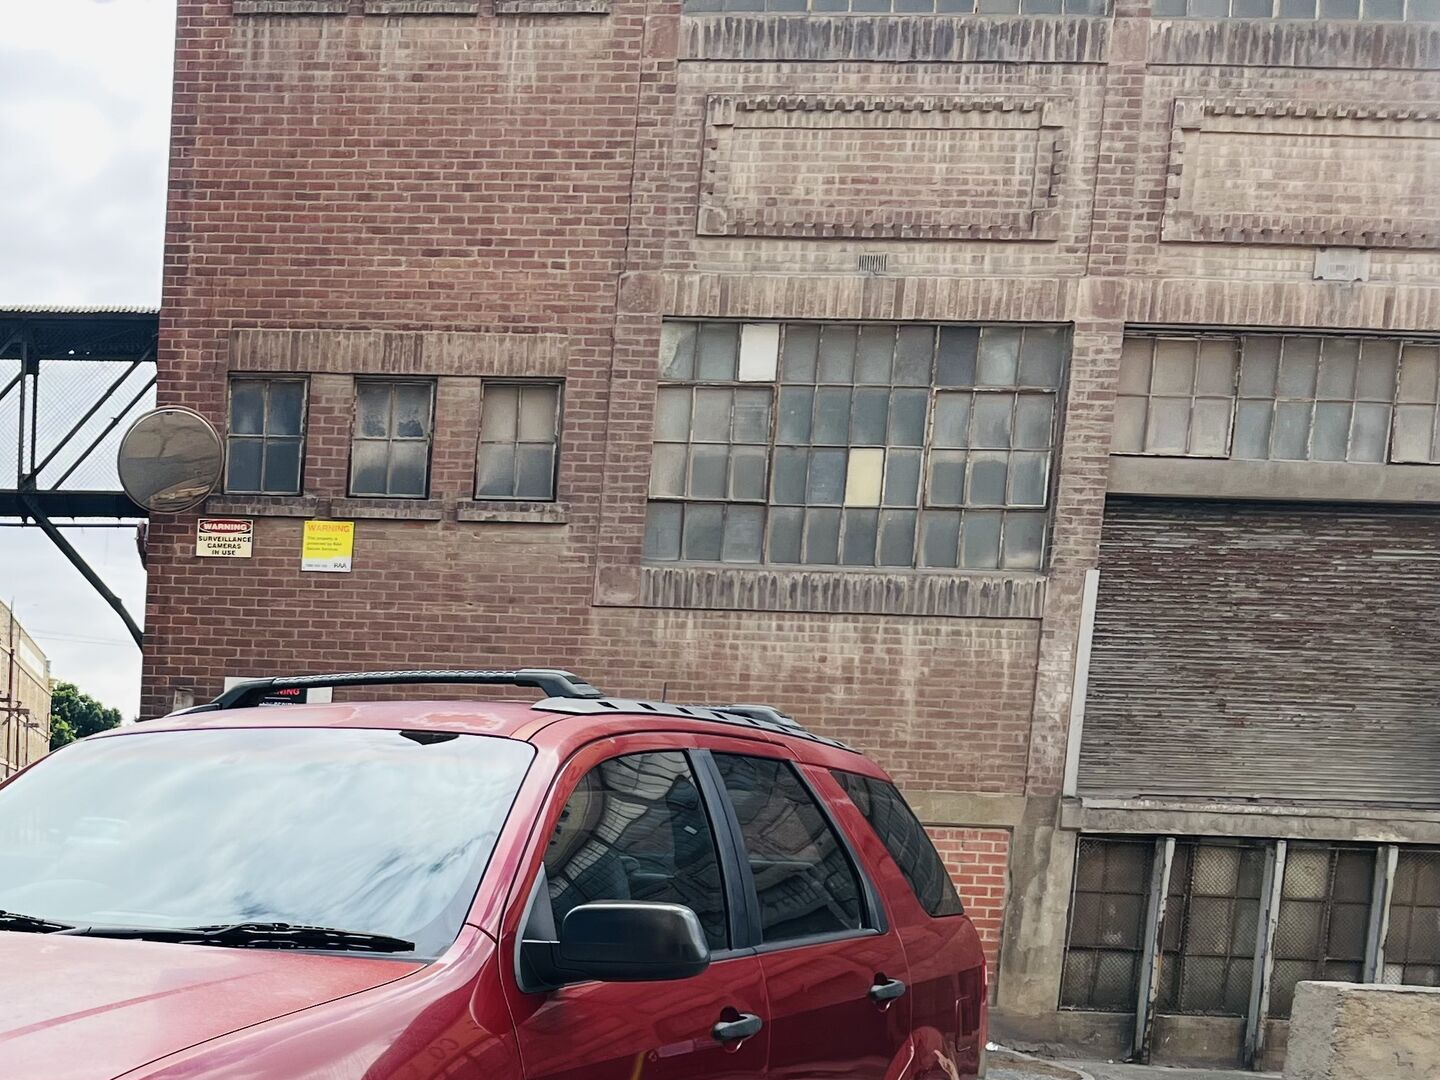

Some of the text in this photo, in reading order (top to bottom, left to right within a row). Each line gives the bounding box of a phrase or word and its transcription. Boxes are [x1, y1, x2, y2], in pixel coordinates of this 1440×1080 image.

[203, 523, 248, 531] WARNING
[307, 524, 351, 533] WARNING
[198, 535, 252, 543] SURVEILLANCE
